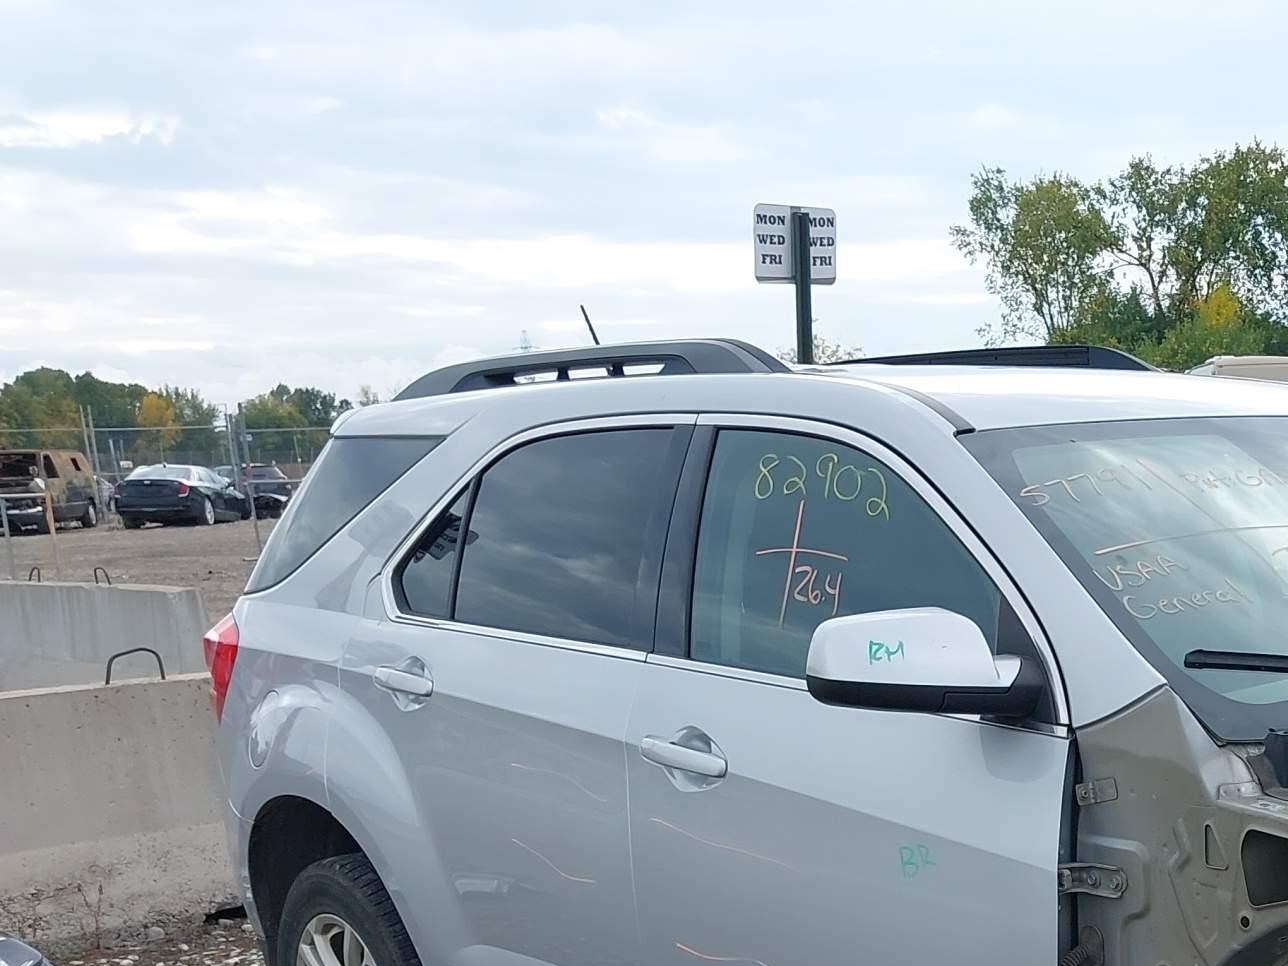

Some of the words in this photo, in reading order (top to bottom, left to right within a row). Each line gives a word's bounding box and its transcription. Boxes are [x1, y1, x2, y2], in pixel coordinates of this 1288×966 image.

[756, 213, 786, 226] MON
[809, 216, 835, 228] MON
[757, 233, 786, 246] WED
[810, 236, 835, 248] WED
[760, 253, 783, 265] FRI
[812, 255, 833, 267] FRI
[753, 452, 891, 521] 82902
[1092, 553, 1186, 593] USAA
[1121, 575, 1253, 621] General
